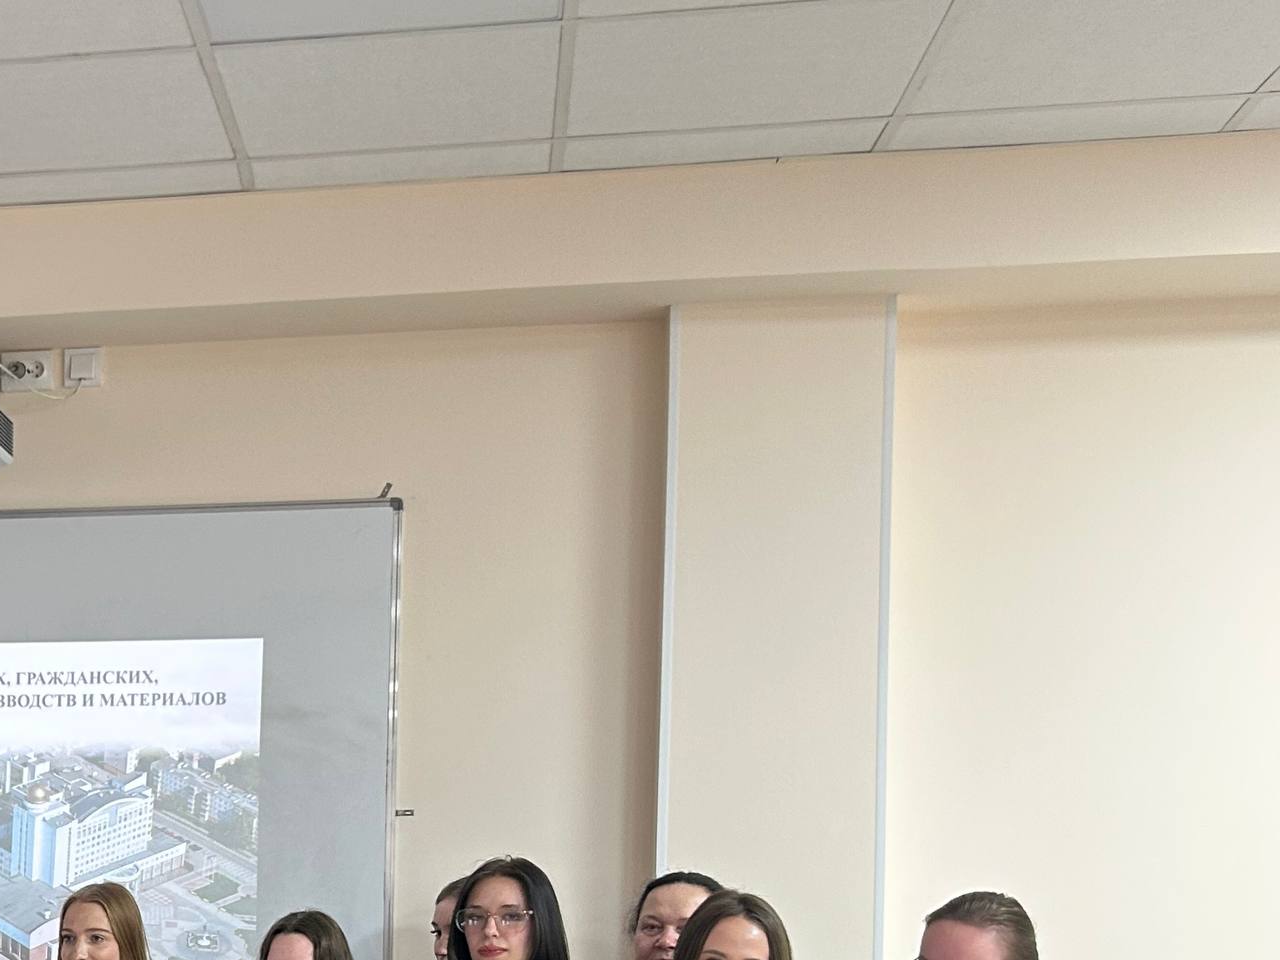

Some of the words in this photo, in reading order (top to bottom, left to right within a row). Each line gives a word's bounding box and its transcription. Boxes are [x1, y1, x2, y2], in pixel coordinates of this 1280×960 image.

[16, 669, 159, 686] ГРАЖДАНСКИХ,
[82, 693, 94, 707] И
[100, 691, 227, 707] МАТЕРИАЛОВ
